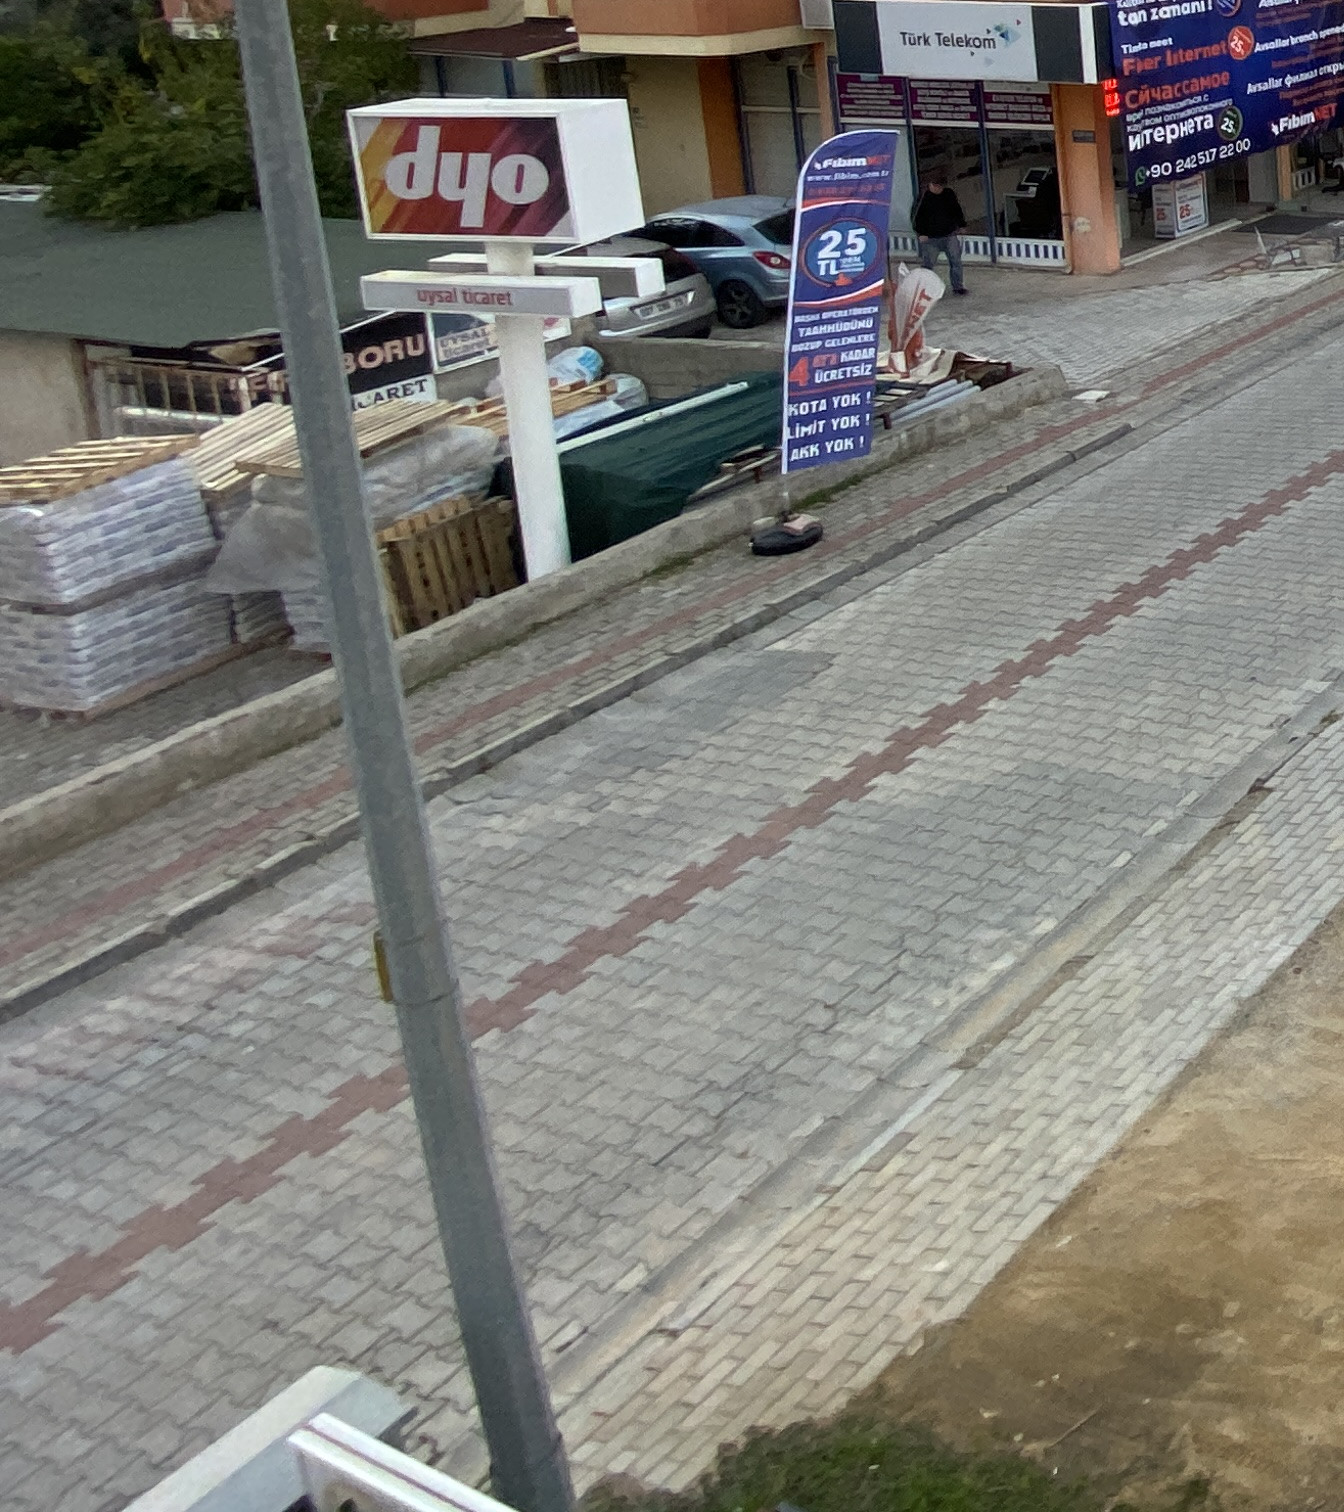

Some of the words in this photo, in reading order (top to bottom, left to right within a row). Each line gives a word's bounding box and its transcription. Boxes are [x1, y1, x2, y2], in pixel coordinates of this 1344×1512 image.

[900, 32, 931, 46] Türk
[935, 32, 996, 49] Telekom
[1176, 155, 1198, 173] 242
[1198, 148, 1217, 164] 517
[1219, 143, 1234, 159] 22
[1236, 138, 1251, 153] 00
[385, 125, 549, 228] dyo
[817, 228, 866, 259] 25
[818, 259, 838, 276] TL
[416, 288, 457, 305] uysal
[462, 287, 512, 306] ticaret
[841, 348, 875, 363] KADAR
[789, 357, 810, 386] 4
[815, 363, 872, 384] ÜCRETSİZ
[788, 399, 827, 417] KOTA
[832, 393, 861, 409] YOK
[787, 419, 826, 439] LİMİT
[831, 414, 860, 431] YOK
[790, 443, 820, 462] AKK
[825, 438, 854, 454] YOK
